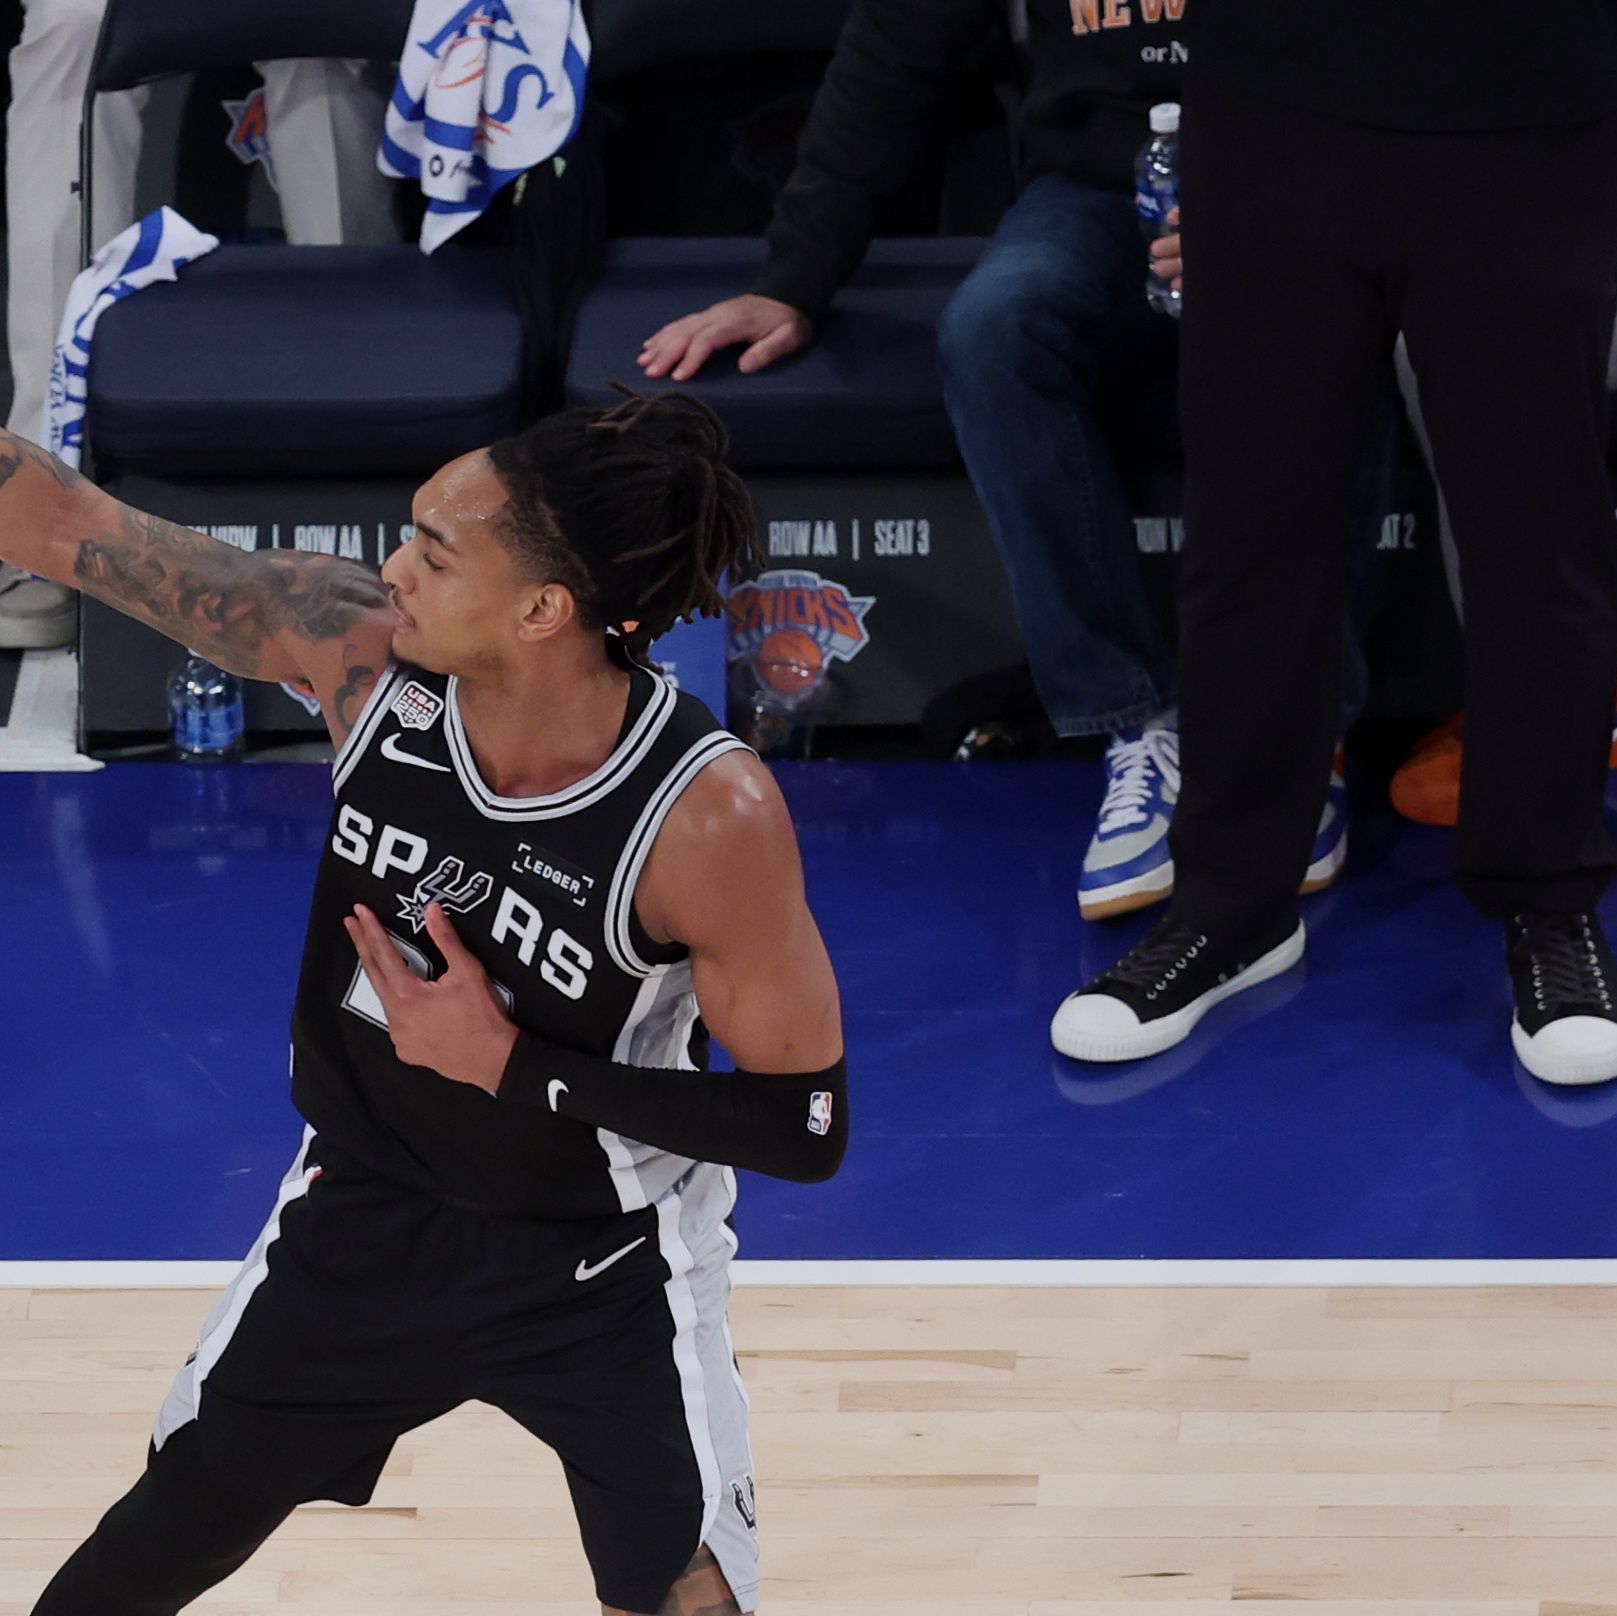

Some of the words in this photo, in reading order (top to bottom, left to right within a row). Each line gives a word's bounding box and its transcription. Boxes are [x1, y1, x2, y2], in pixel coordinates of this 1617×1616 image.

[1141, 46, 1169, 63] or
[769, 521, 814, 557] ROW
[813, 520, 838, 557] AA
[874, 519, 915, 557] SEAT
[916, 519, 931, 557] 3
[395, 699, 431, 726] 250
[407, 685, 437, 713] USA
[523, 854, 581, 896] LEDGER
